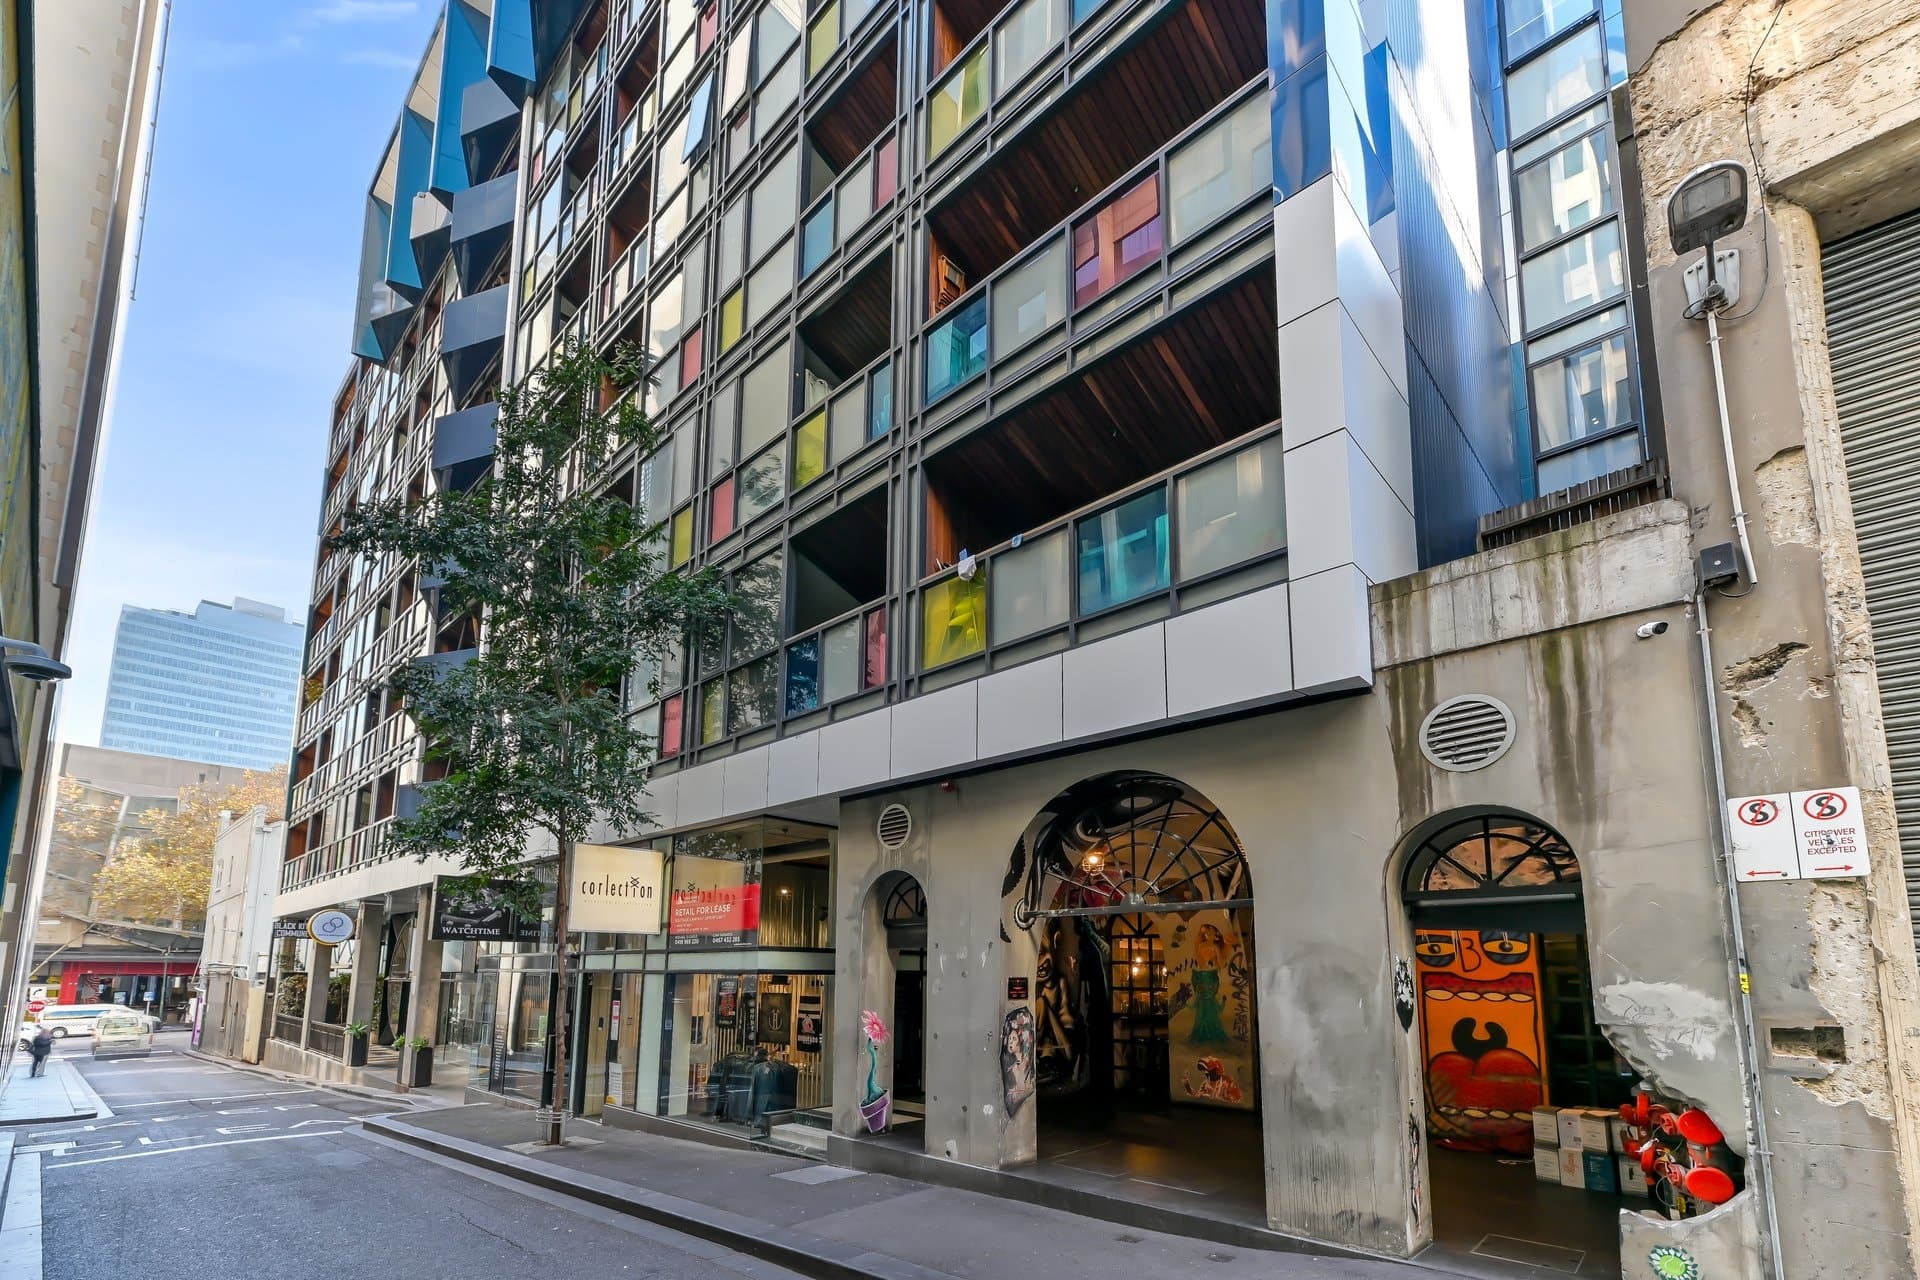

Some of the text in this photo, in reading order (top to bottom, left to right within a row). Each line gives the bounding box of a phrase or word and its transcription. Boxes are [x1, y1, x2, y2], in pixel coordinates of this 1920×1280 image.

[1807, 846, 1857, 855] EXCEPTED
[675, 904, 731, 917] RETAIL FOR LEASE
[442, 927, 500, 936] WATCHTIME
